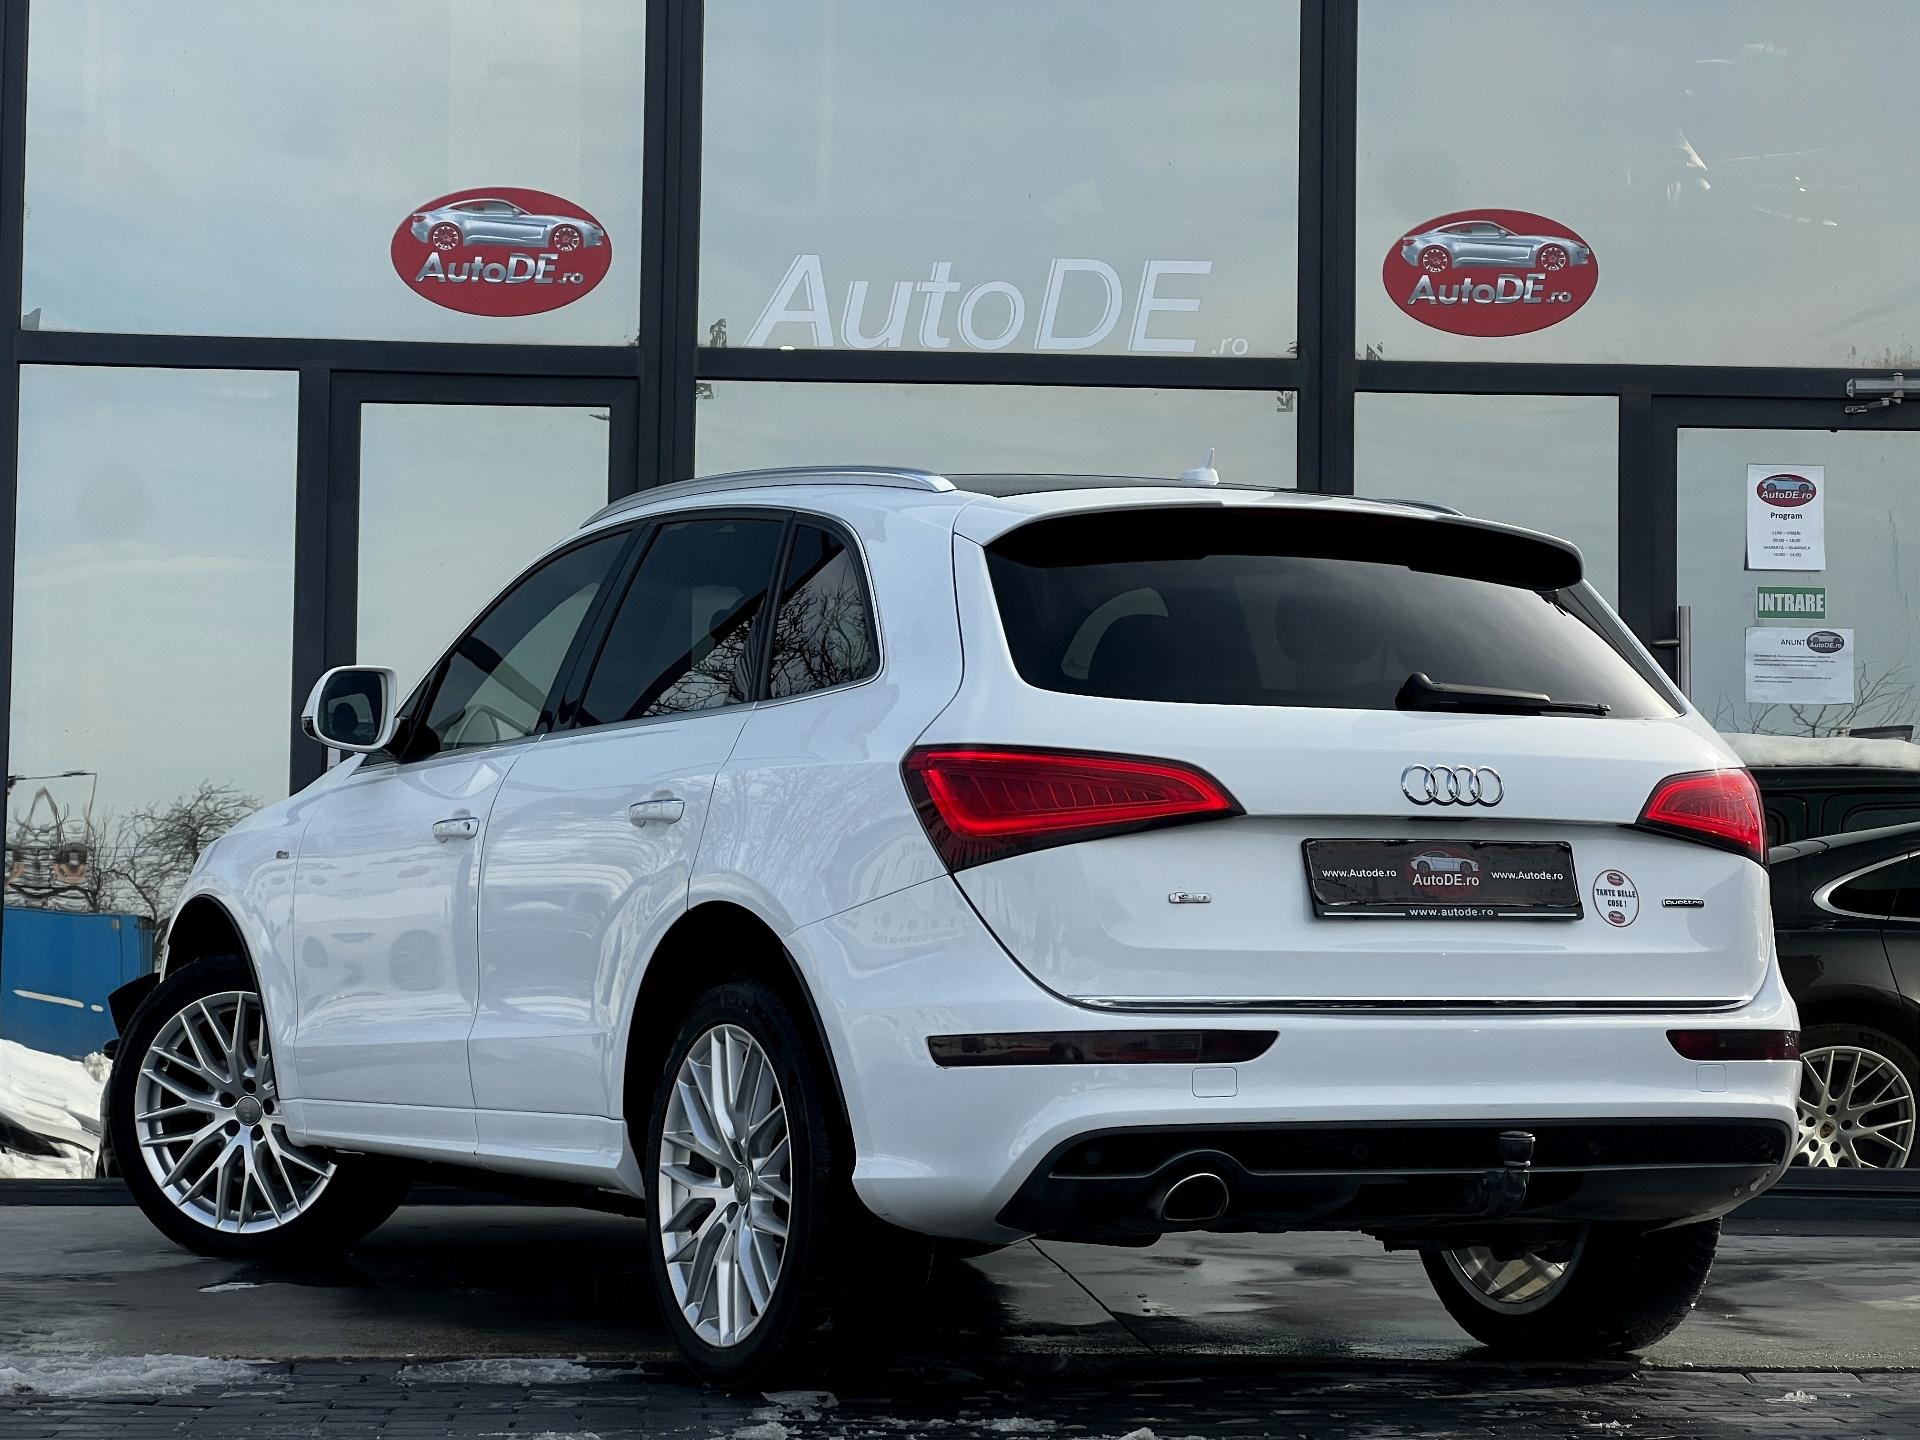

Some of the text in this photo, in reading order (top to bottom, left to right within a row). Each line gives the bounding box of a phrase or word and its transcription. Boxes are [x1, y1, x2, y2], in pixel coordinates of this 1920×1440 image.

[1761, 490, 1813, 500] AutoDE.ro
[1770, 512, 1803, 520] Program
[1758, 592, 1825, 612] INTRARE
[1322, 868, 1397, 878] www.Autode.ro
[1491, 869, 1564, 880] www.Autode.ro
[1412, 873, 1480, 887] AutoDE.ro
[1596, 888, 1636, 898] TANTE BELLE
[1409, 907, 1494, 917] www.autode.ro
